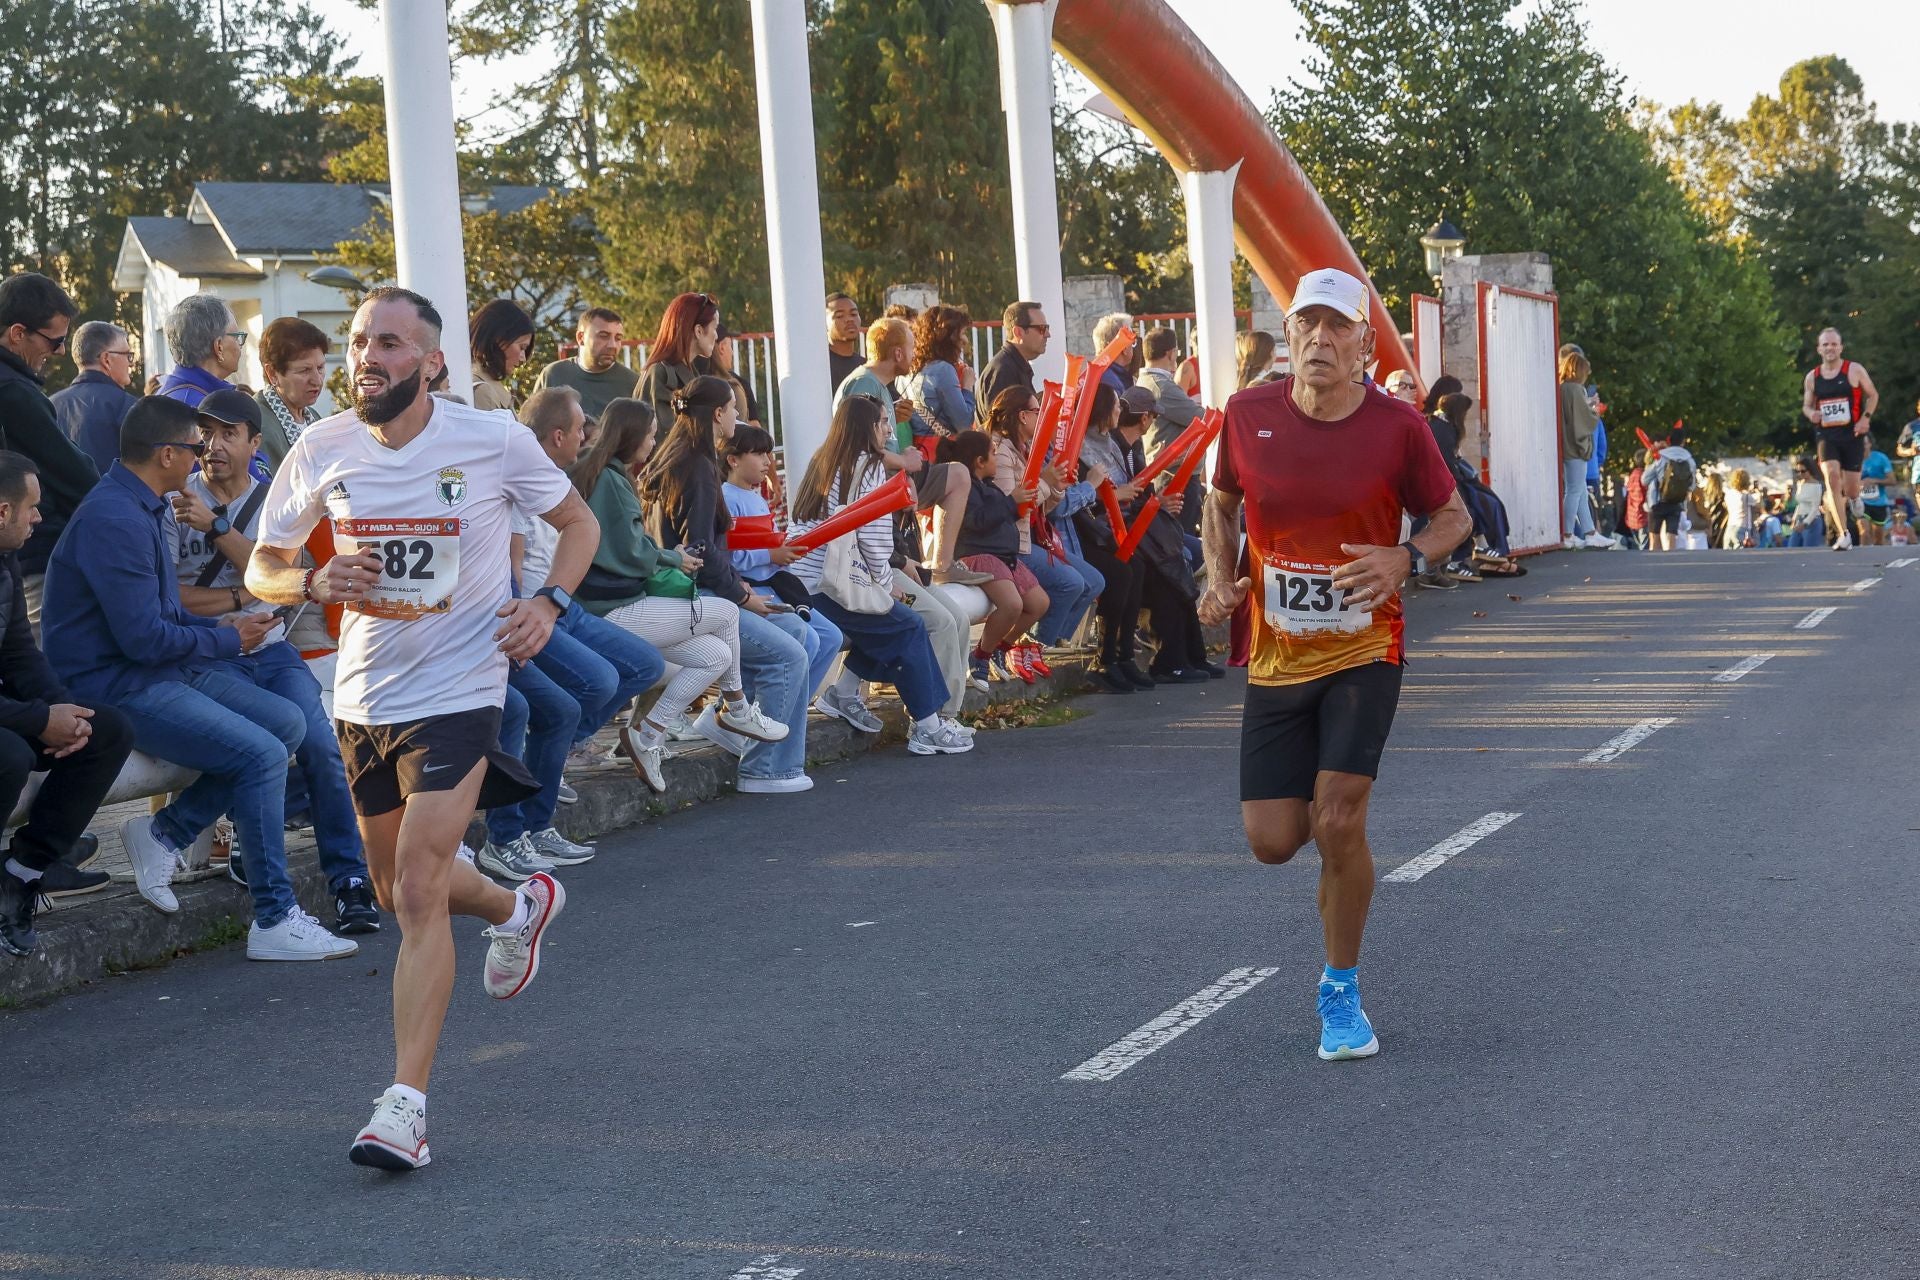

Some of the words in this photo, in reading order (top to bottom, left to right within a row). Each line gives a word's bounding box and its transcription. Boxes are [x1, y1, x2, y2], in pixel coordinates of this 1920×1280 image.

[1054, 420, 1067, 451] MBA
[370, 523, 395, 532] MBA
[414, 522, 440, 532] GIJÓN
[1290, 561, 1312, 570] MBA
